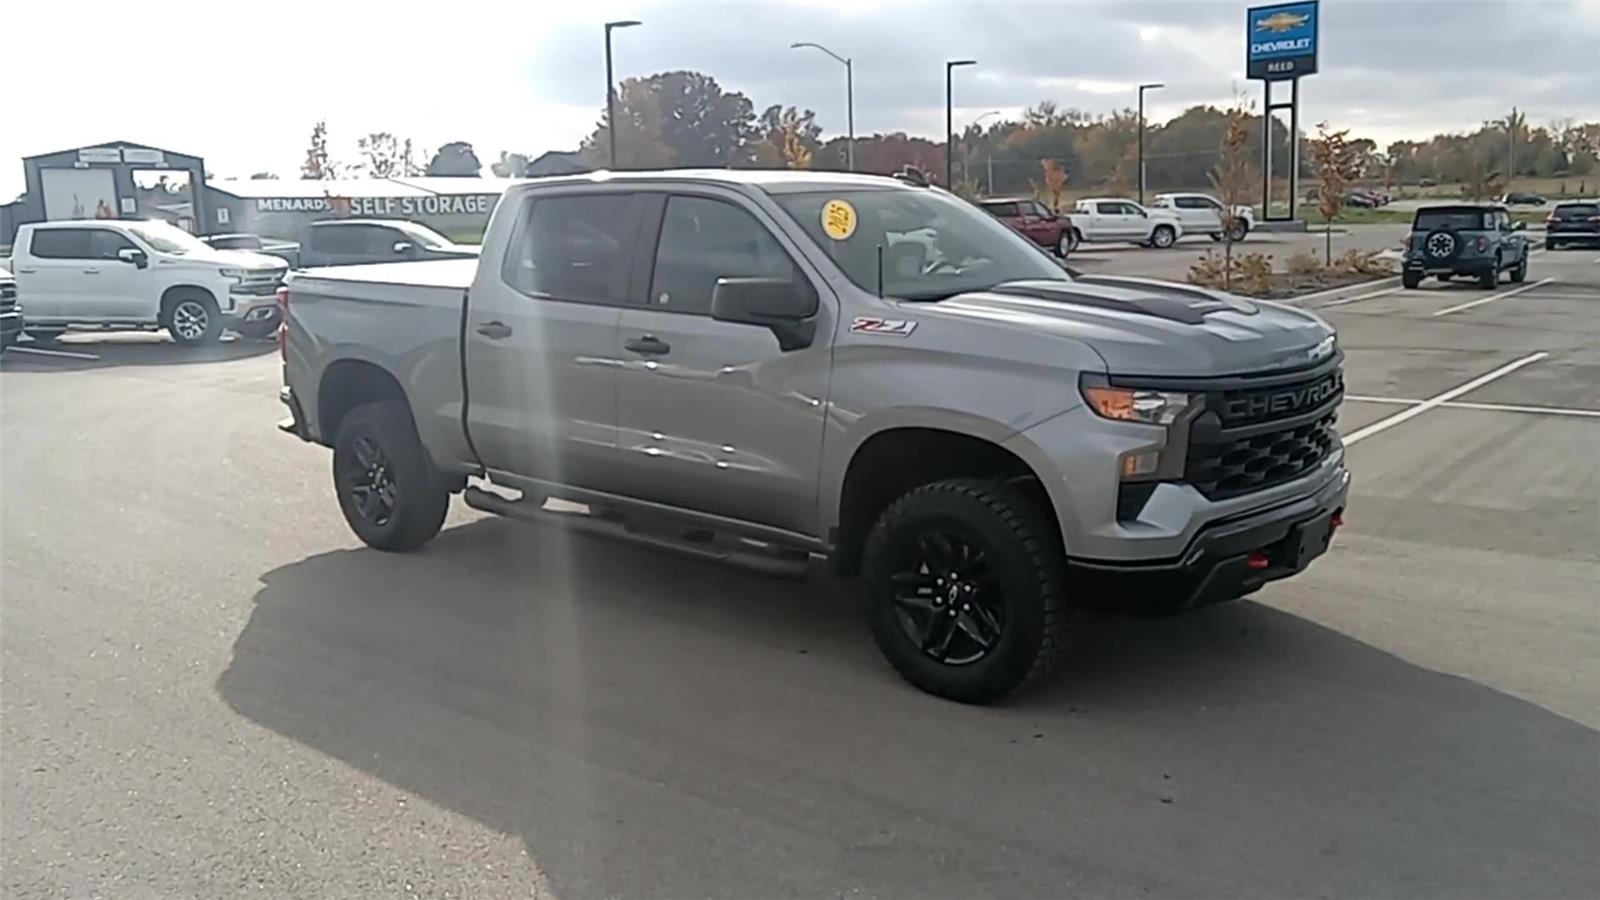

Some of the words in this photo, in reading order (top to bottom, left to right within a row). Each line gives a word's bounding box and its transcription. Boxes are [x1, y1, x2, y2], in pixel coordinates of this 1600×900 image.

[1251, 38, 1310, 54] CHEVROLET
[1267, 61, 1294, 72] REED
[257, 198, 332, 211] MENARDS
[350, 198, 396, 215] SELF
[402, 195, 487, 214] STORAGE
